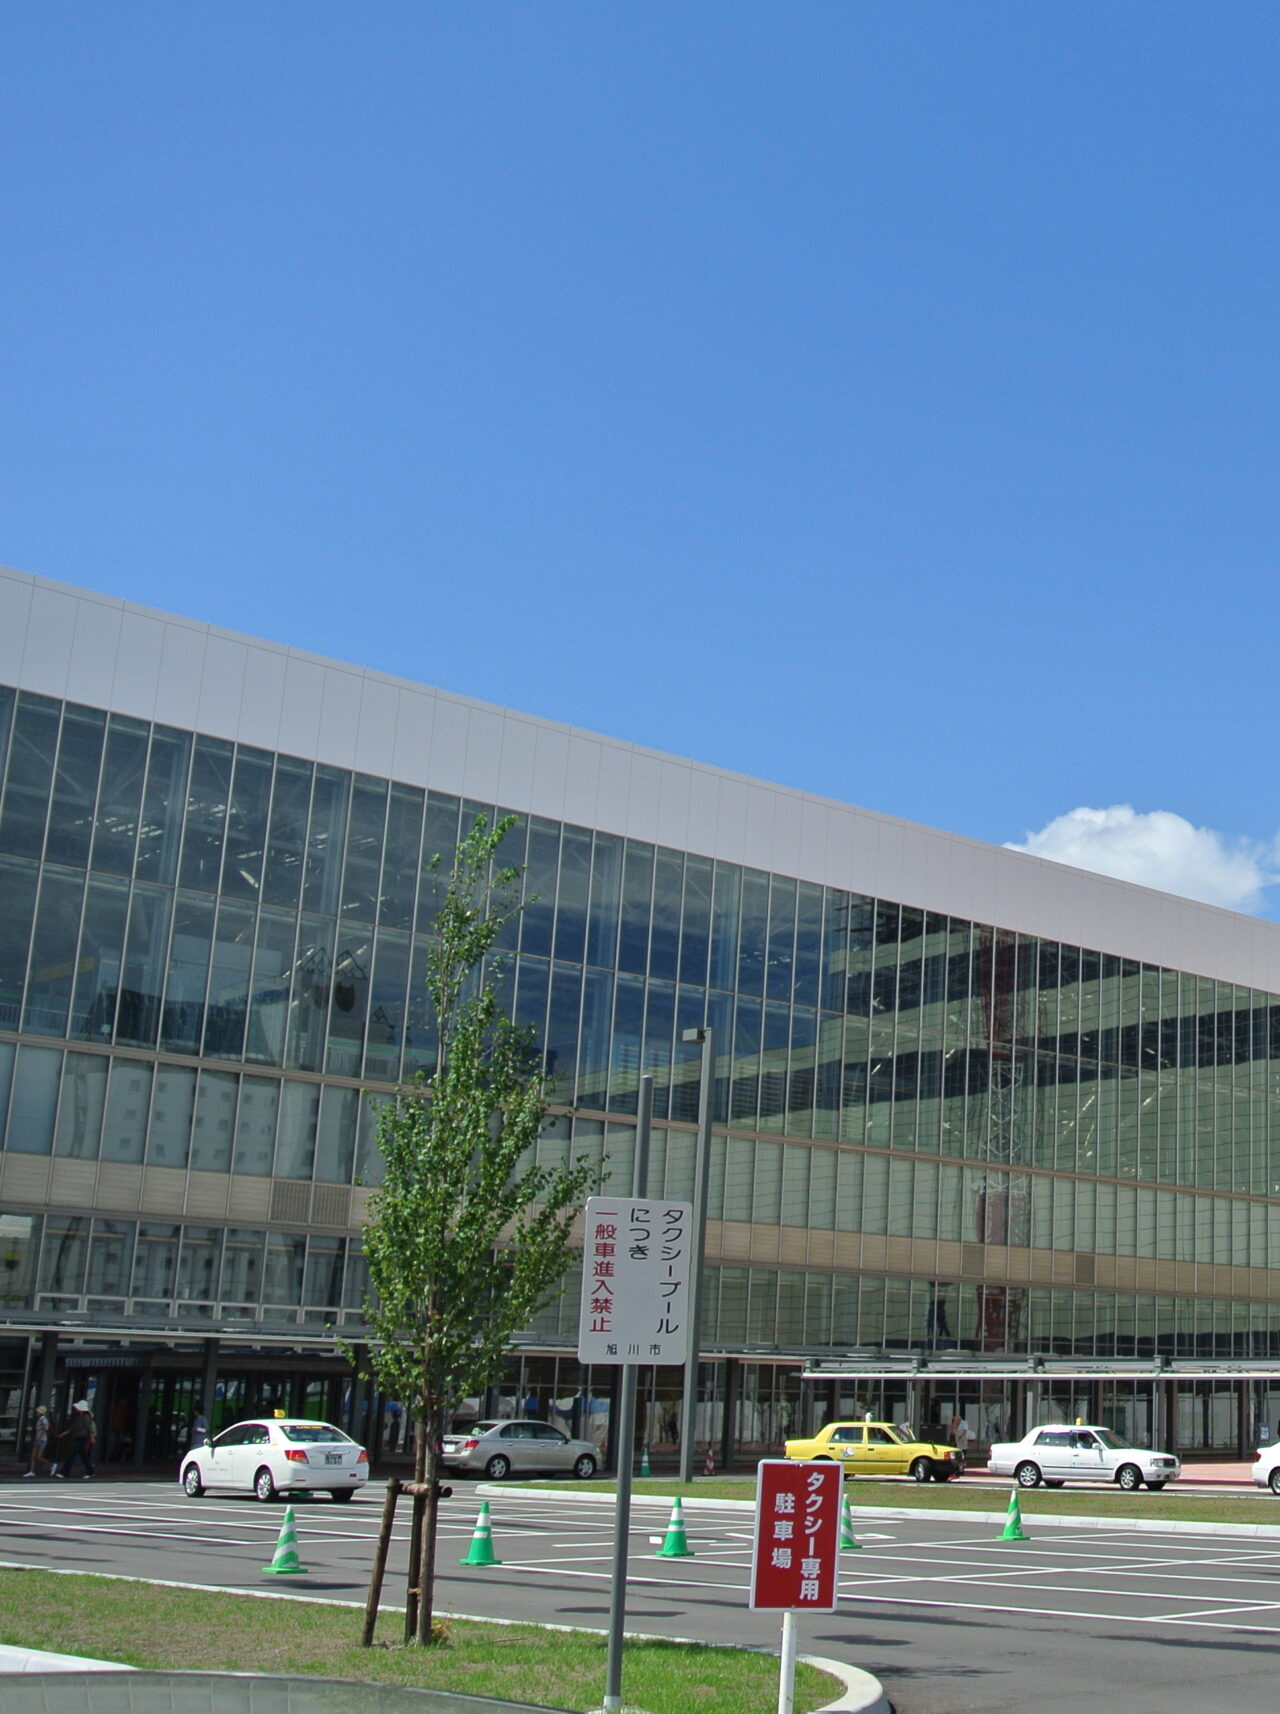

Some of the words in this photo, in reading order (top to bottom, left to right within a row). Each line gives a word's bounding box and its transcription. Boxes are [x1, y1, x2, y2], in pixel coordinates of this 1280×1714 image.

[589, 1211, 618, 1333] 一般車進入禁止
[628, 1207, 651, 1260] につき
[656, 1209, 684, 1334] タクシープール
[606, 1343, 661, 1356] 旭川市
[771, 1492, 796, 1569] 駐車場
[799, 1471, 825, 1601] タクシー専用
